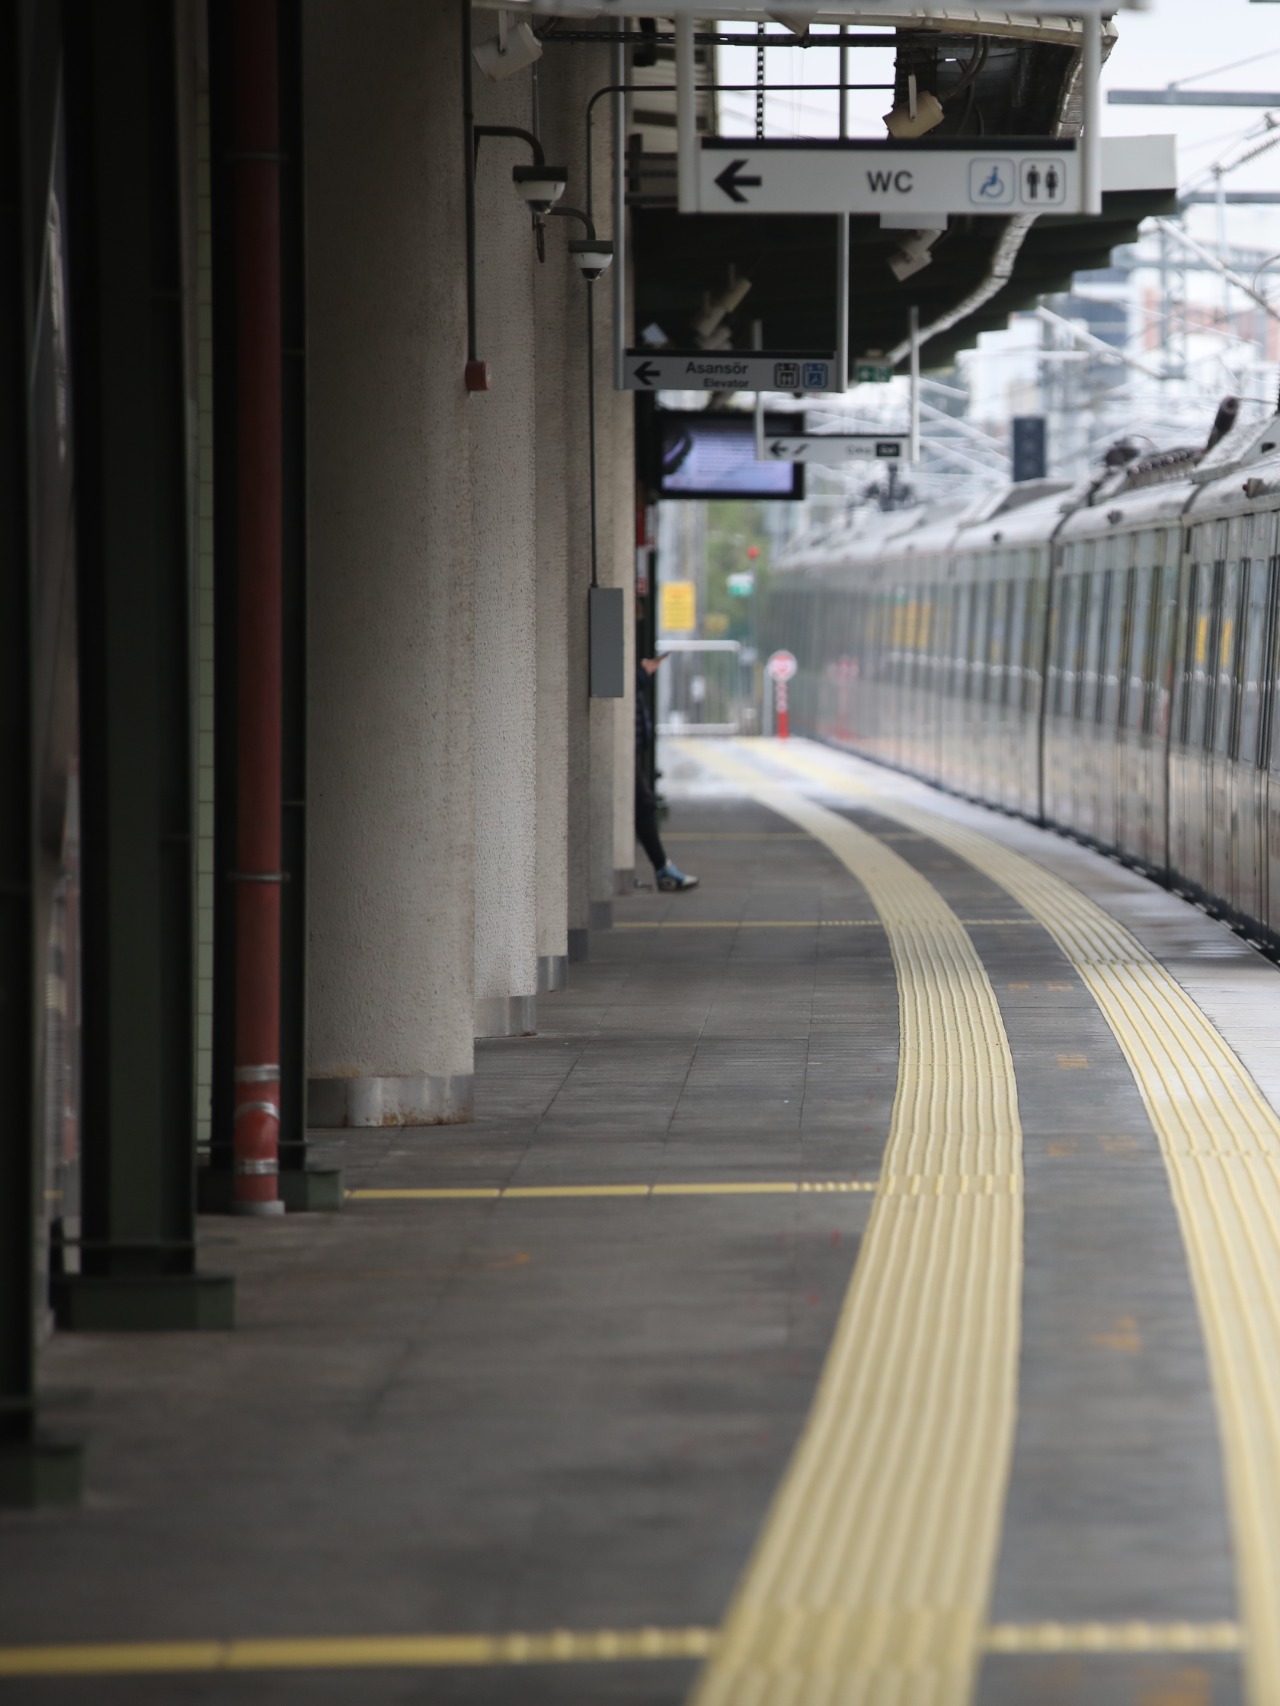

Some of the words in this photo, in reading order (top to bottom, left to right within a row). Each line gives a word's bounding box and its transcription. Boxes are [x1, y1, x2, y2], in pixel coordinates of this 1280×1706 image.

[867, 170, 913, 193] WC
[685, 361, 749, 375] Asansör
[703, 377, 750, 389] Elevator
